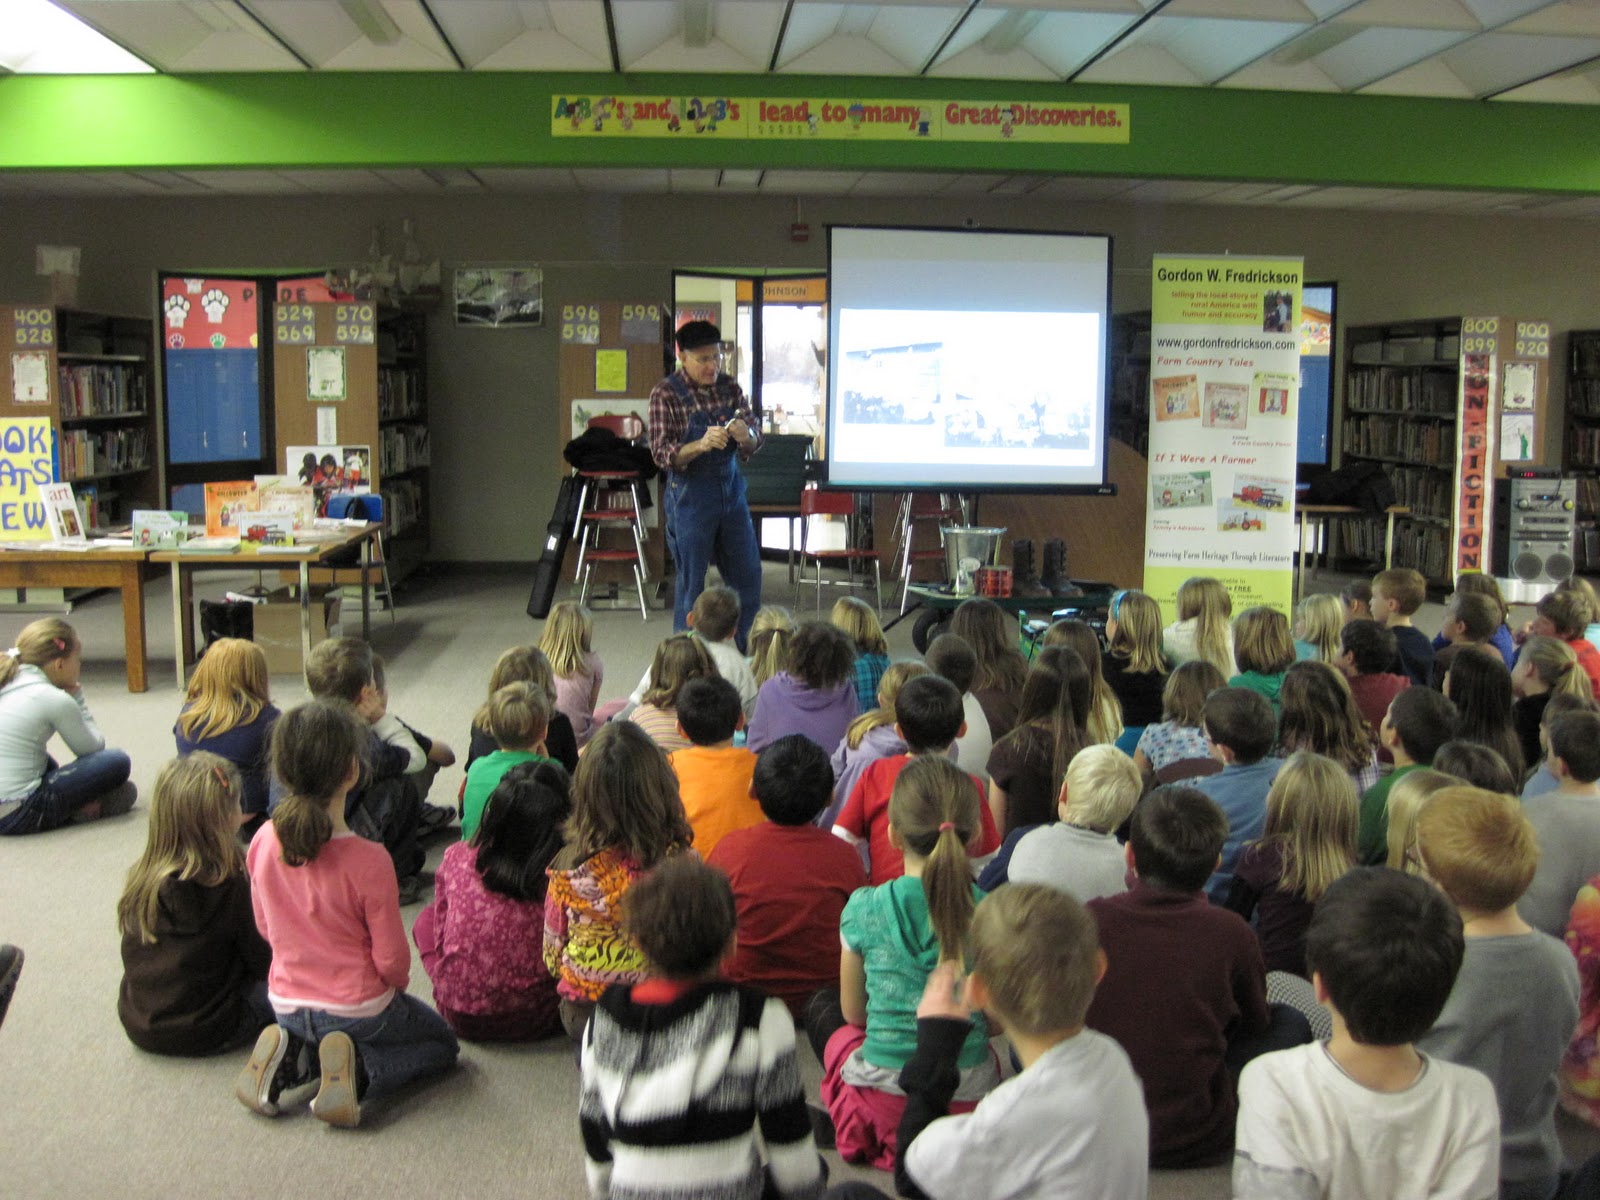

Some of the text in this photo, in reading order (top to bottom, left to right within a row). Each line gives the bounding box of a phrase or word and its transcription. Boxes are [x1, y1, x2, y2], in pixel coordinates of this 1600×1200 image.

[633, 99, 671, 120] and
[760, 100, 809, 122] lead
[821, 101, 847, 123] to
[861, 105, 920, 130] many
[945, 102, 1001, 125] Great
[1010, 104, 1122, 127] Discoveries.
[1157, 268, 1298, 284] Gordon W. Fredrickson
[1196, 291, 1208, 299] the
[1229, 292, 1248, 300] story
[15, 309, 52, 325] 400
[277, 305, 313, 321] 529
[337, 305, 373, 321] 570
[563, 305, 599, 321] 596
[277, 325, 313, 341] 569
[337, 325, 373, 341] 595
[563, 324, 599, 339] 599
[1464, 320, 1498, 334] 800
[1517, 322, 1549, 338] 900
[16, 328, 53, 344] 528
[1157, 337, 1296, 350] www.gordonfredrickson.com
[1464, 338, 1495, 352] 899
[1517, 340, 1548, 355] 920
[1157, 356, 1254, 368] Farm Country Tales
[0, 426, 47, 453] OK
[1155, 453, 1257, 465] If I Were A Farmer
[49, 486, 70, 501] art
[1148, 549, 1290, 562] Preserving Farm Heritage Through Literature
